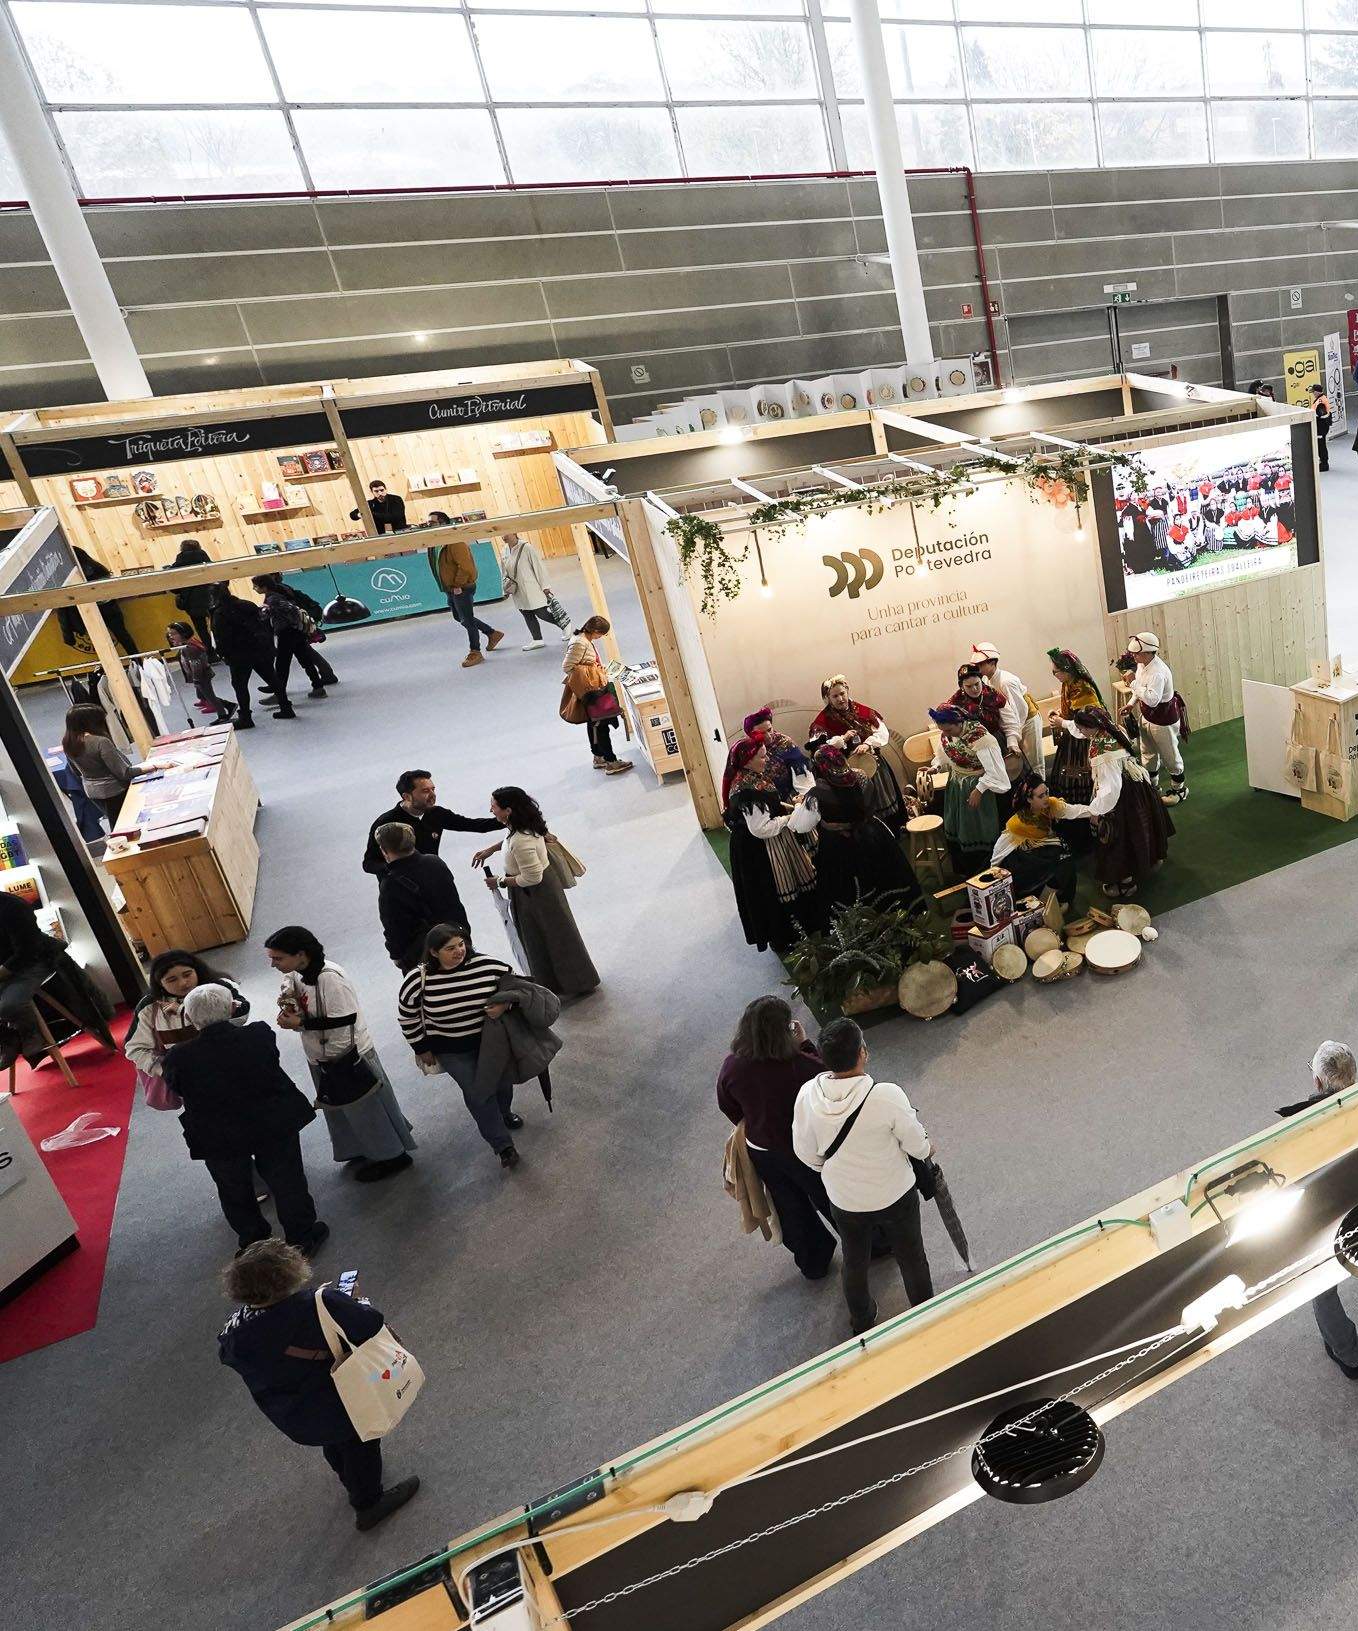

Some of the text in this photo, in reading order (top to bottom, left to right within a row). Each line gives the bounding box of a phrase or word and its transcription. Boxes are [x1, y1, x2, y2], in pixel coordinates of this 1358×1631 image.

[184, 427, 250, 453] Editora
[891, 531, 990, 562] Deputación
[894, 548, 993, 578] Potevedra
[867, 588, 968, 621] Unha provincia
[850, 600, 990, 645] para cantar a cultura
[8, 882, 32, 893] LUME
